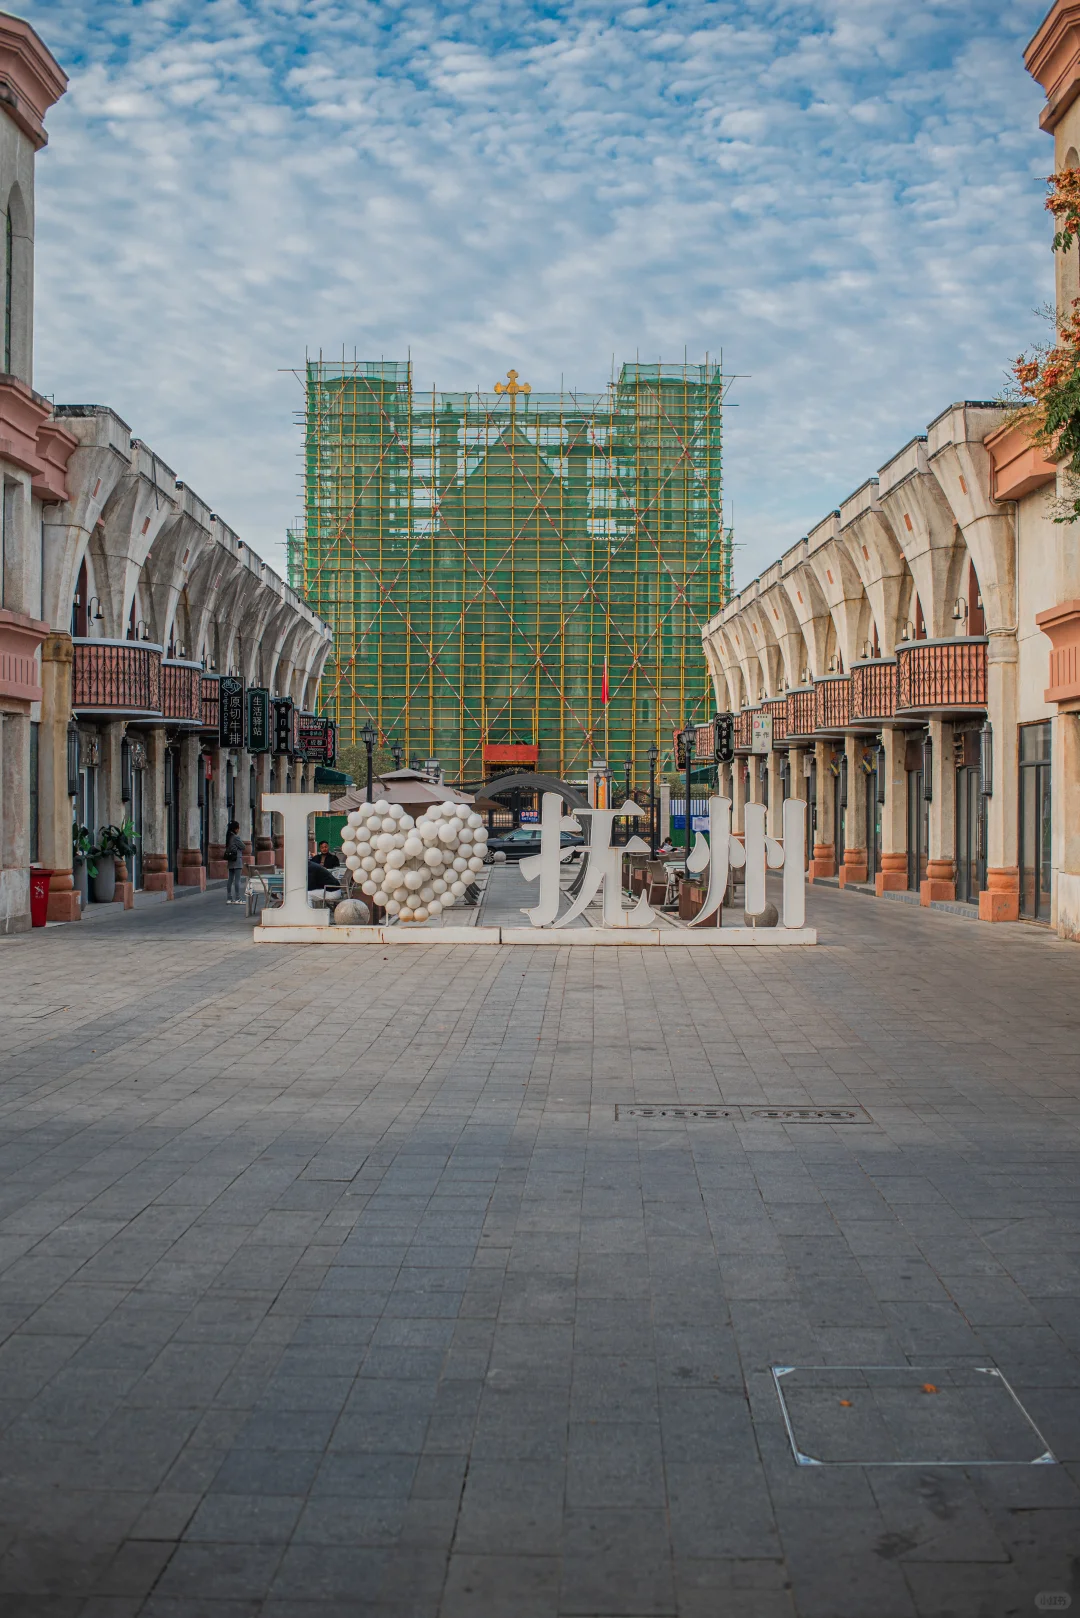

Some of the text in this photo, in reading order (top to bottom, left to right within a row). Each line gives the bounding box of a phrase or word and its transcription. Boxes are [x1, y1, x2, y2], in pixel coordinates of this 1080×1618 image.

[229, 696, 241, 744] 原切牛排
[252, 696, 262, 736] 生活驿站
[753, 720, 771, 729] DIY
[755, 731, 770, 739] 手作
[519, 791, 807, 929] 抚州
